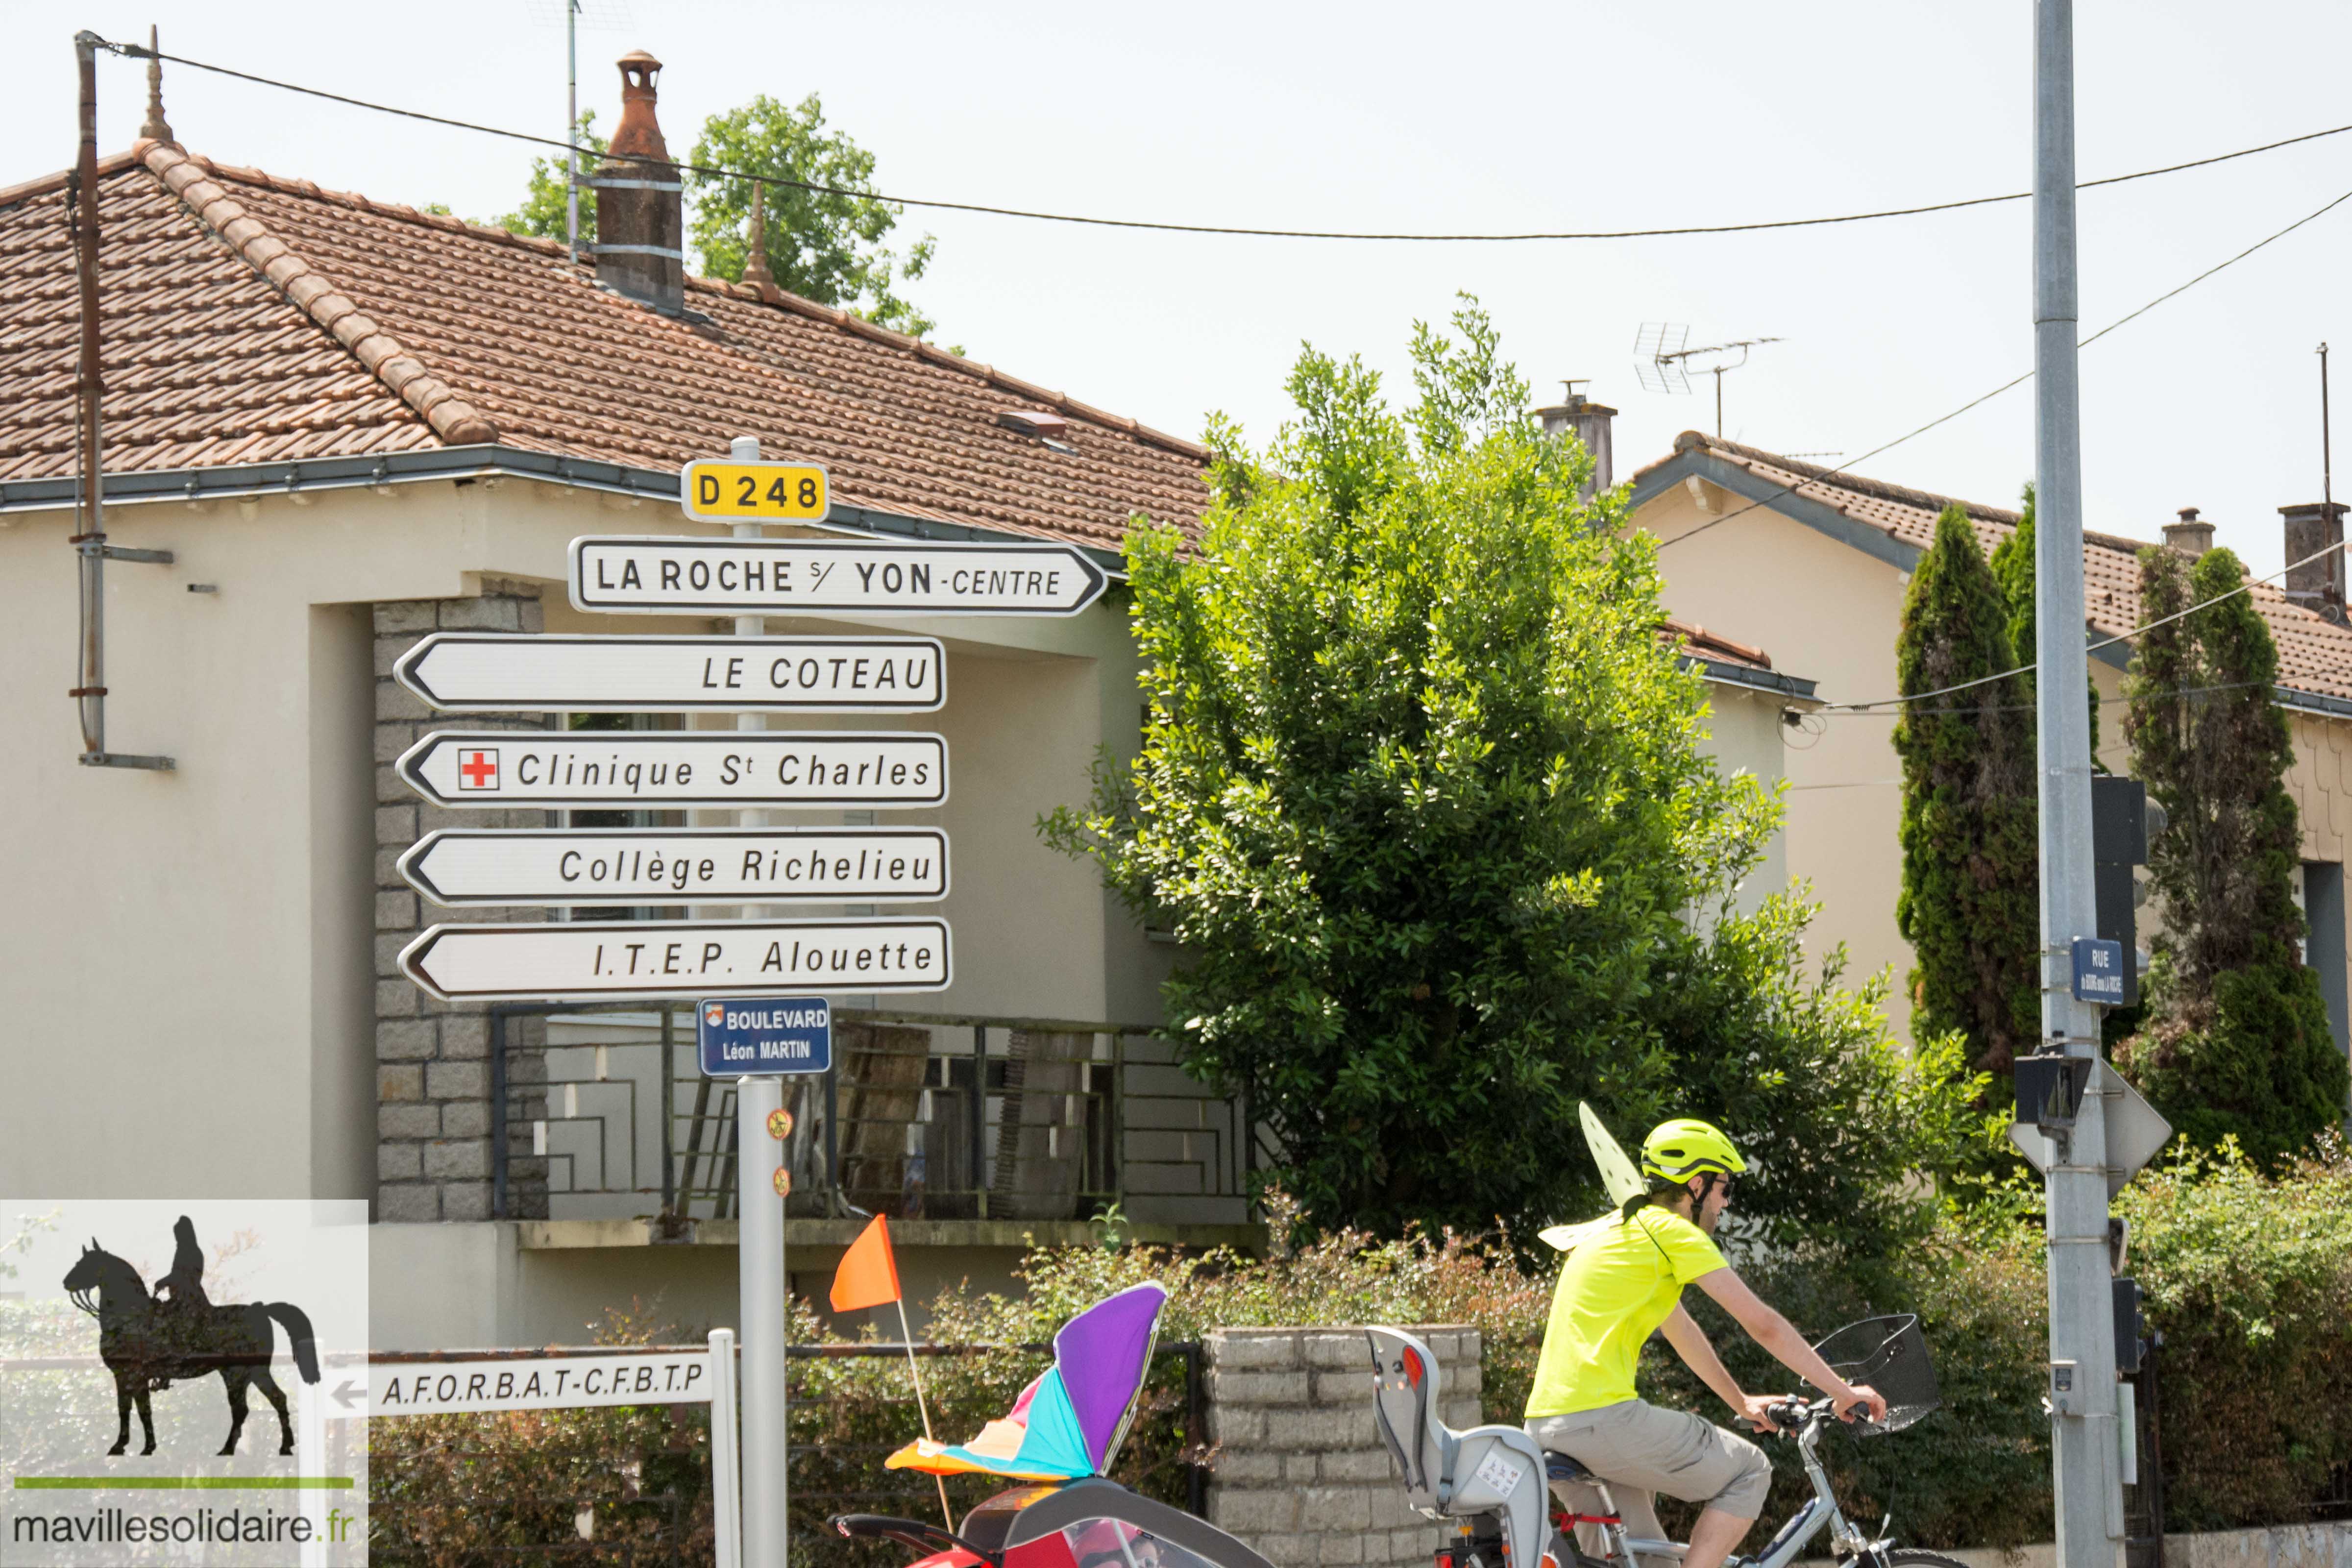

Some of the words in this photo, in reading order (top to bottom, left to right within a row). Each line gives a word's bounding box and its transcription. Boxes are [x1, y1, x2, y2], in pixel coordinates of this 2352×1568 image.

[700, 475, 719, 505] D
[737, 476, 817, 509] 248
[598, 559, 641, 590] LA
[661, 560, 792, 592] ROCHE
[855, 563, 931, 594] YON
[703, 658, 744, 688] LE
[770, 658, 927, 689] COTEAU
[518, 754, 692, 794] Clinique
[719, 754, 753, 786] St
[778, 754, 929, 786] Charles
[560, 850, 714, 891] Collège
[741, 849, 930, 881] Richelieu
[594, 943, 733, 976] I.T.E.P.
[760, 941, 931, 972] Alouette
[2092, 949, 2109, 968] RUE
[726, 1009, 828, 1030] BOULEVARD
[722, 1042, 755, 1060] Léon
[760, 1039, 811, 1059] MARTIN
